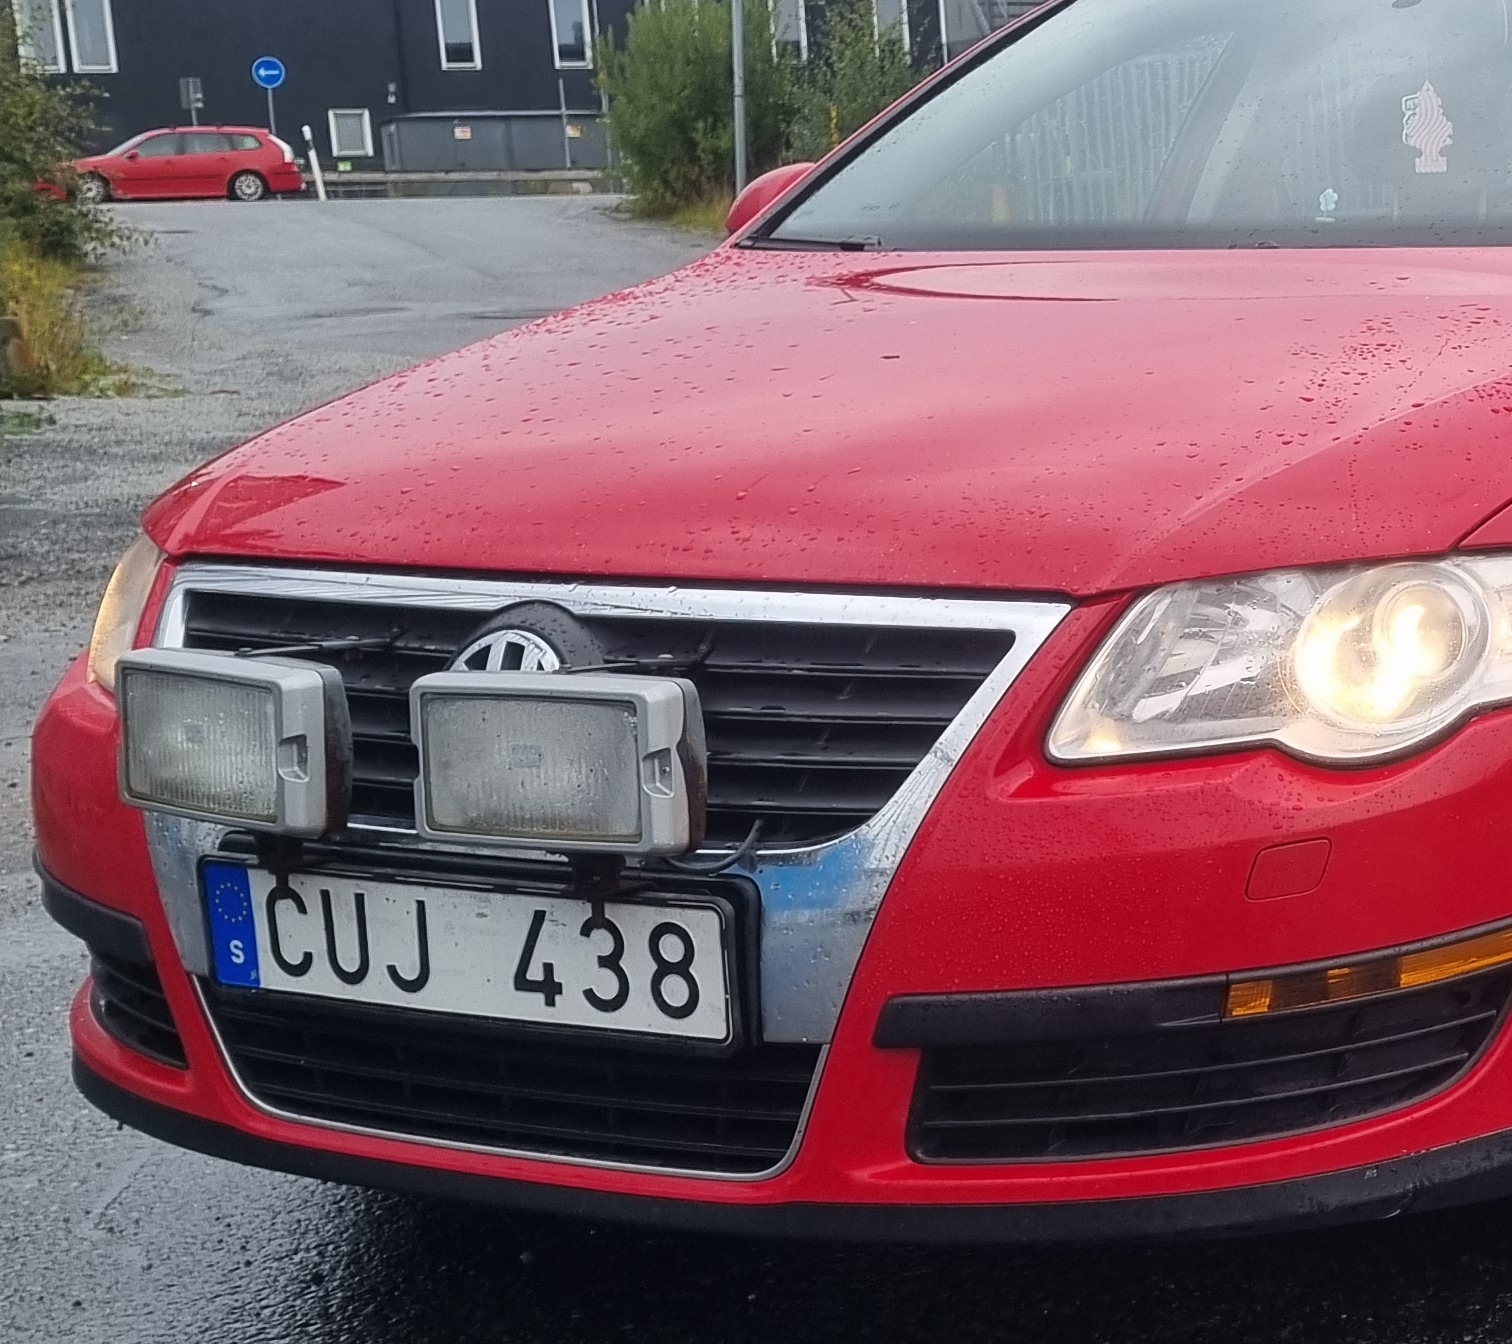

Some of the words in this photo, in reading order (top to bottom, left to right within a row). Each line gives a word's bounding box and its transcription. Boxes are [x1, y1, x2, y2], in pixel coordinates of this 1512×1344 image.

[229, 939, 245, 964] S
[265, 885, 431, 994] CUJ
[513, 909, 700, 1020] 438
